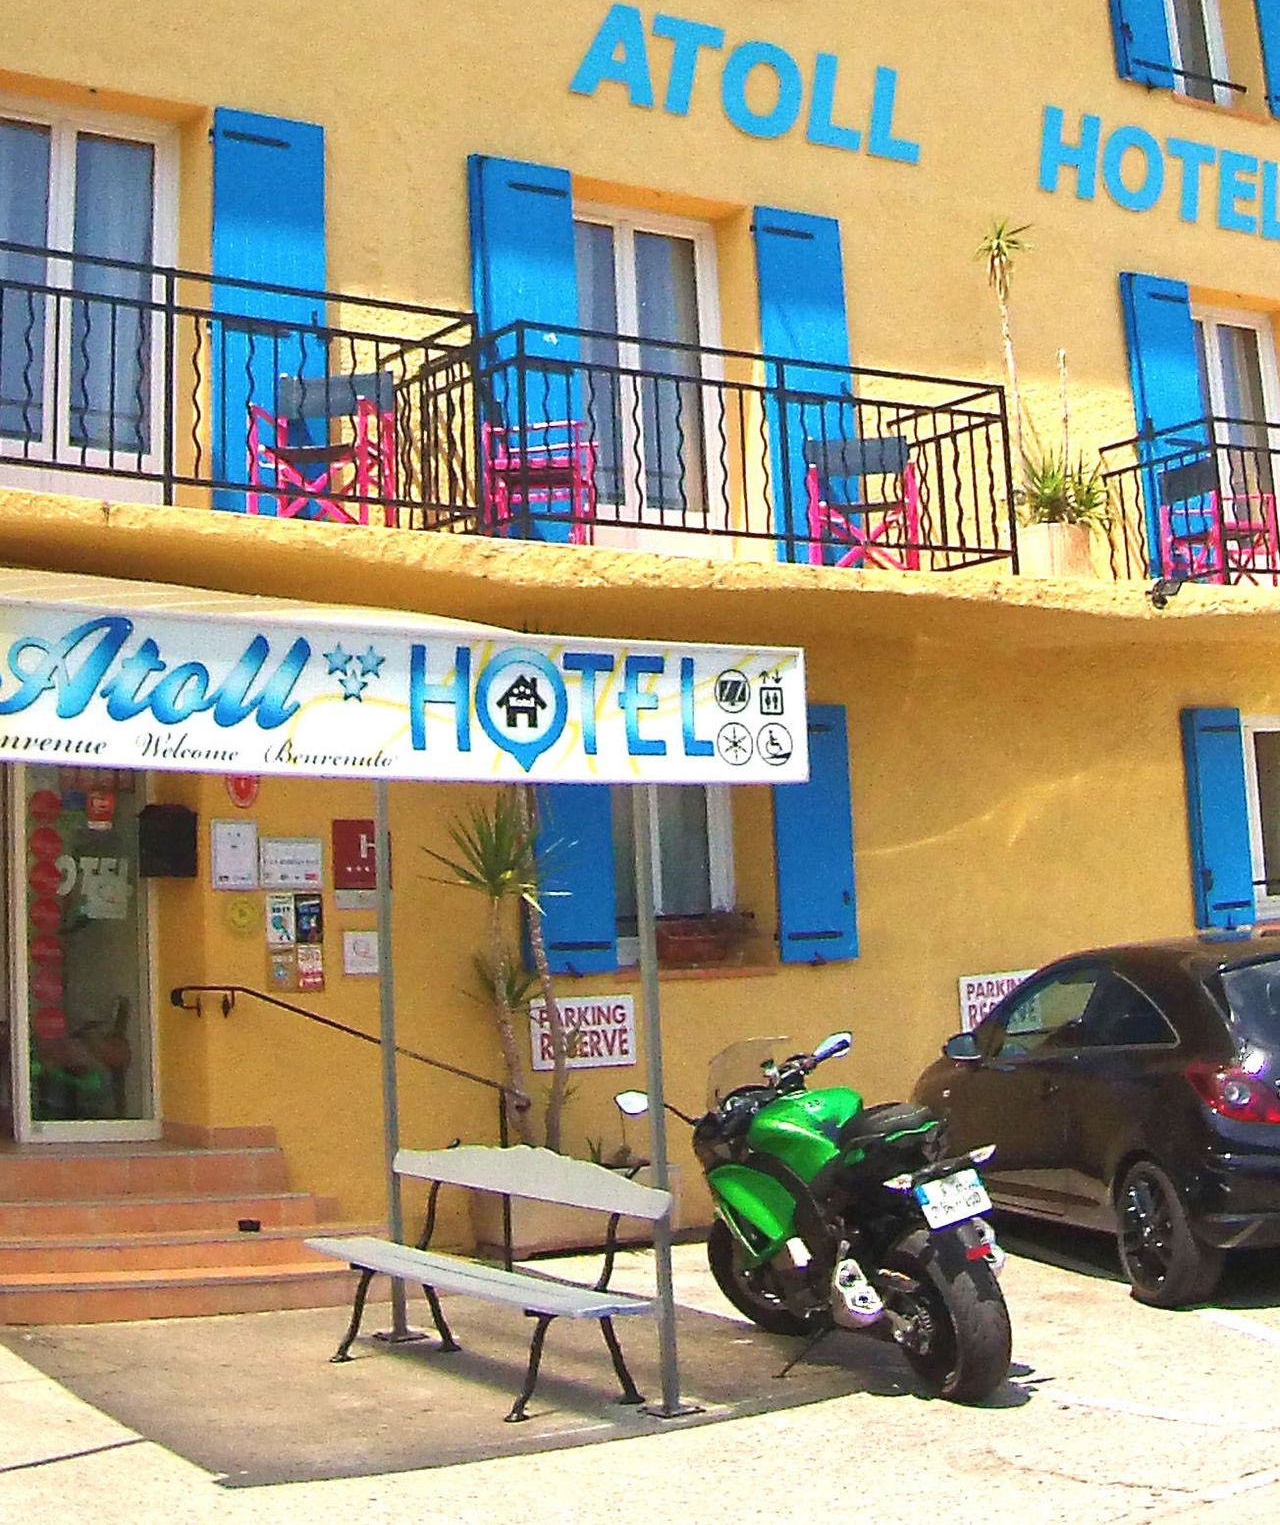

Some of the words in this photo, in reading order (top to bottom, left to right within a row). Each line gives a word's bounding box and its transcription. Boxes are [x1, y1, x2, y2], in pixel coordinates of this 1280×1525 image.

[570, 3, 920, 165] ATOLL
[135, 731, 241, 763] Welcome
[409, 643, 716, 772] HOTEL
